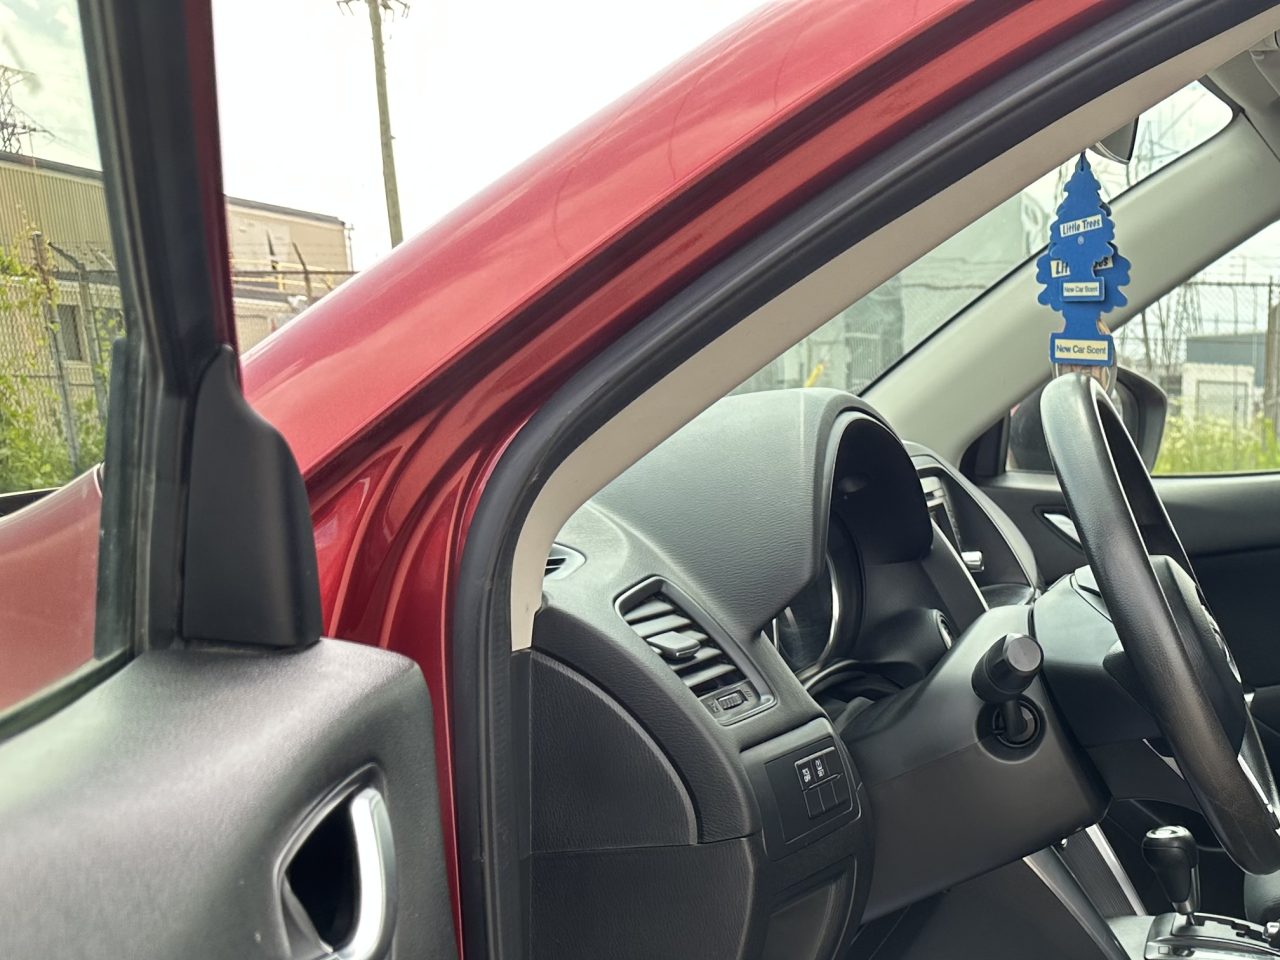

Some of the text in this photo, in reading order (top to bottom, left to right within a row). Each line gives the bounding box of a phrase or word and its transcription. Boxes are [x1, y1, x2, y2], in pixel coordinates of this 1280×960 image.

[1062, 218, 1100, 235] Little Trees
[1075, 285, 1083, 293] Car
[1085, 285, 1098, 293] Scent
[1056, 344, 1106, 355] New Car Scent
